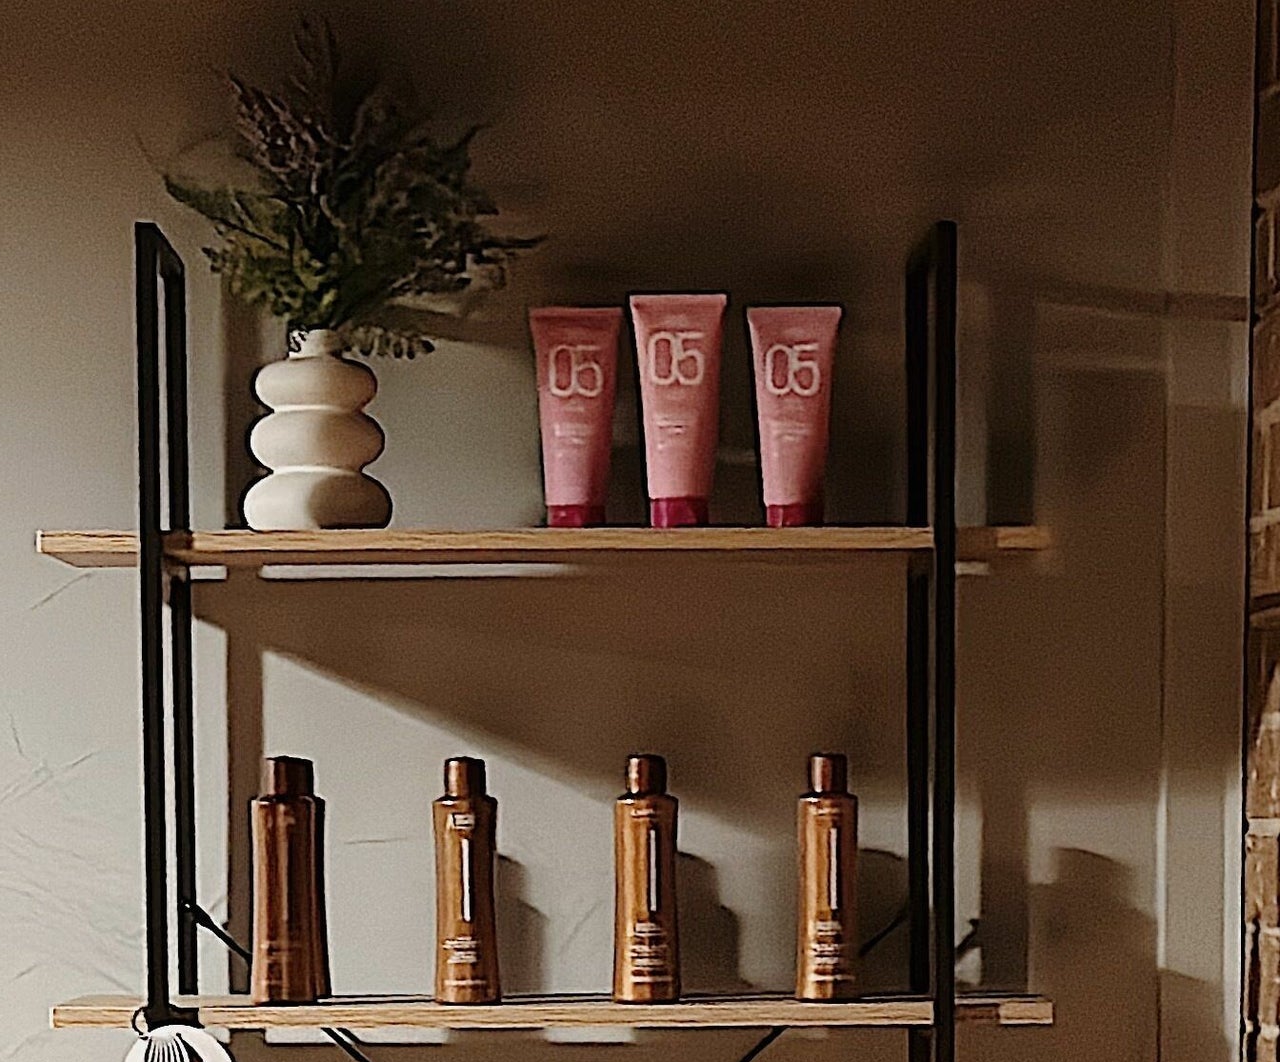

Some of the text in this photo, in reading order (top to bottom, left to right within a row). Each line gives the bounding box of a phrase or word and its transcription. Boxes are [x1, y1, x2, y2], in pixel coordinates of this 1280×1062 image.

[549, 345, 603, 397] 05
[648, 331, 705, 386] 05
[765, 343, 820, 397] 05
